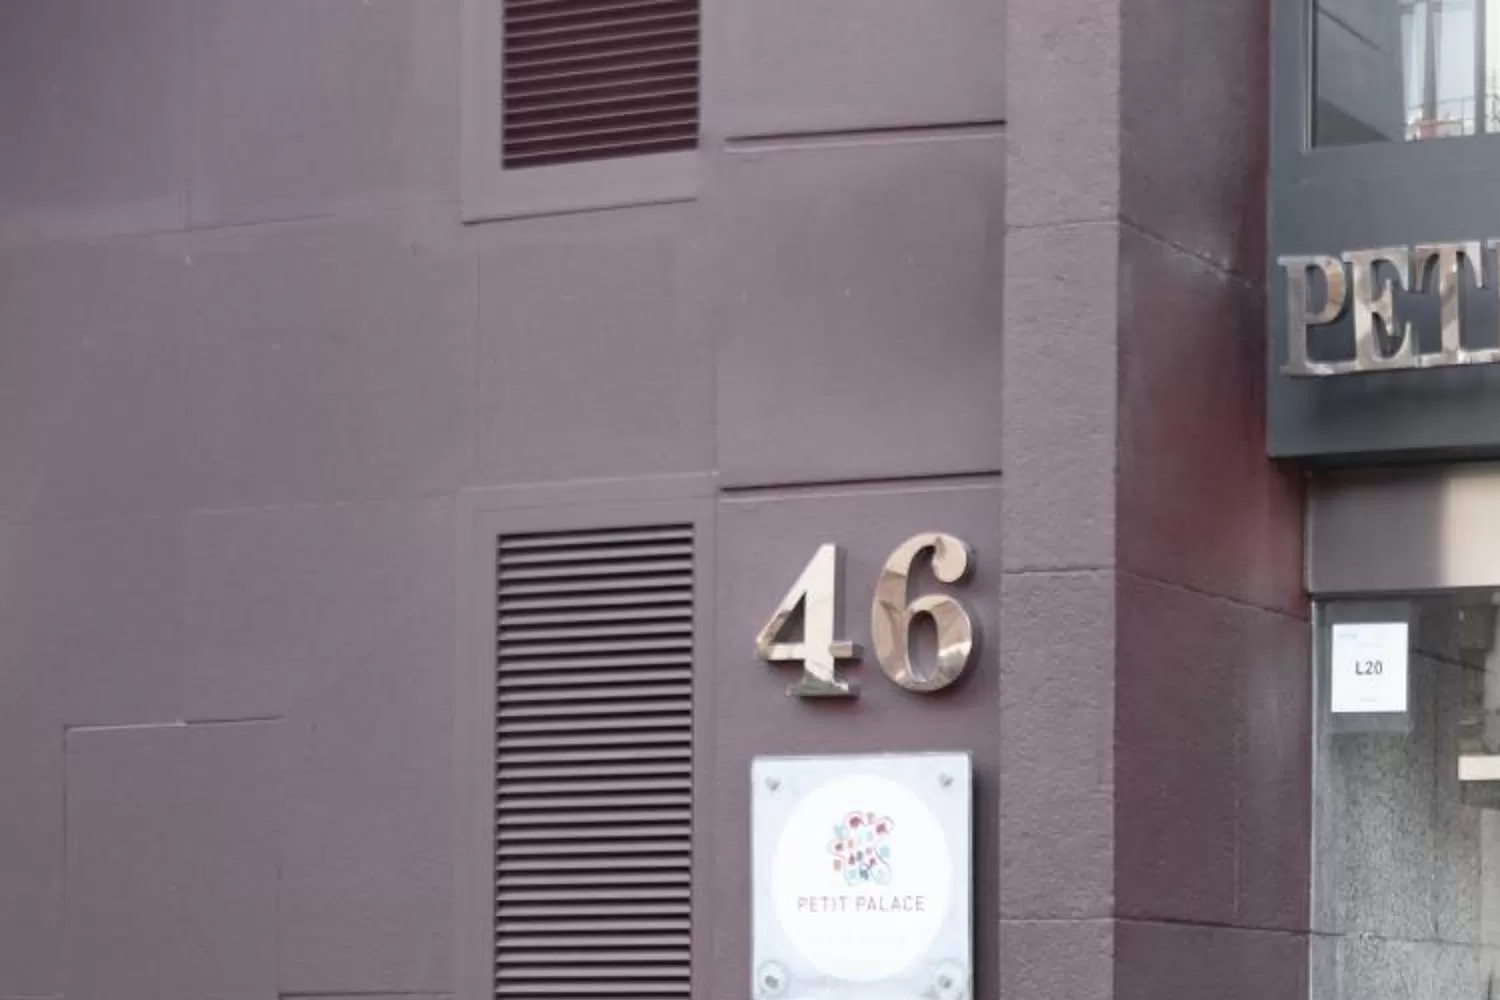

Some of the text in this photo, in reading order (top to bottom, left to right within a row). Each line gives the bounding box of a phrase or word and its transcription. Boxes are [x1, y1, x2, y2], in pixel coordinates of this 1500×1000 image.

[755, 531, 981, 698] 46
[1355, 660, 1383, 675] L20
[797, 895, 926, 912] PETIT PALACE
